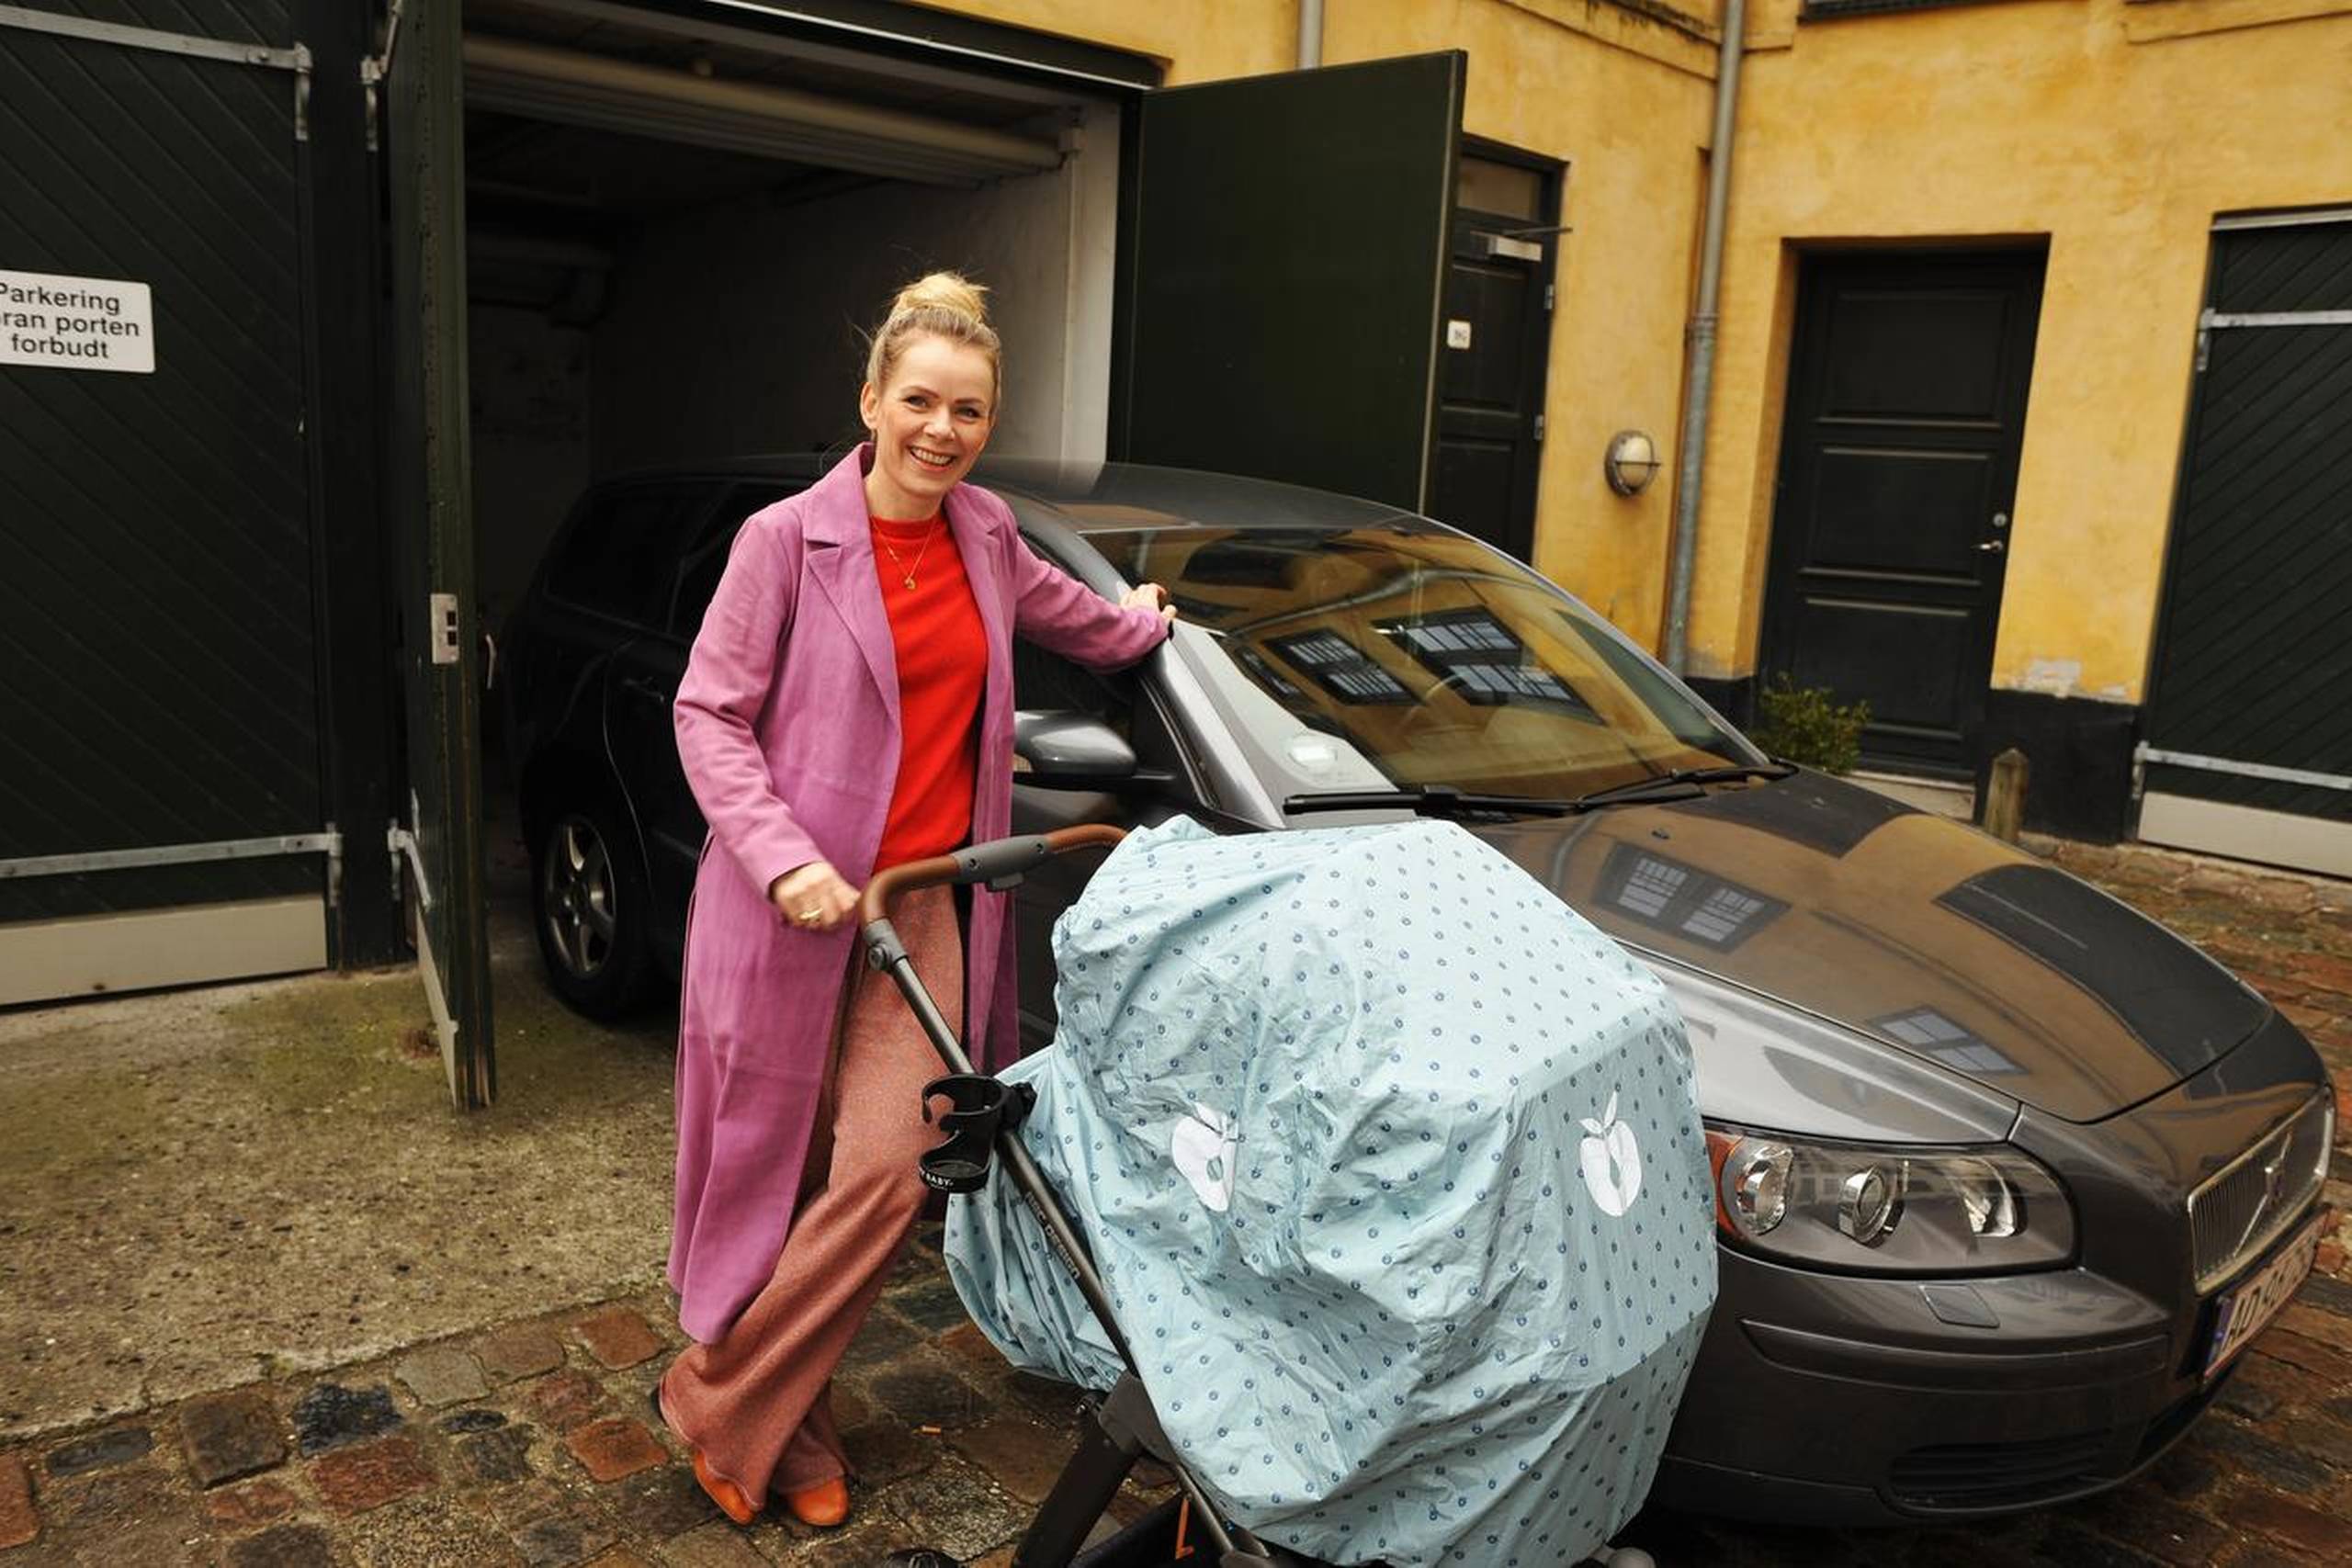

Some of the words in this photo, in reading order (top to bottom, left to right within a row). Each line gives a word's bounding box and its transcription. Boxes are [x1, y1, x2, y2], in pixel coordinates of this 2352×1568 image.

[0, 311, 45, 329] ran
[56, 316, 139, 336] porten
[11, 333, 108, 358] forbudt
